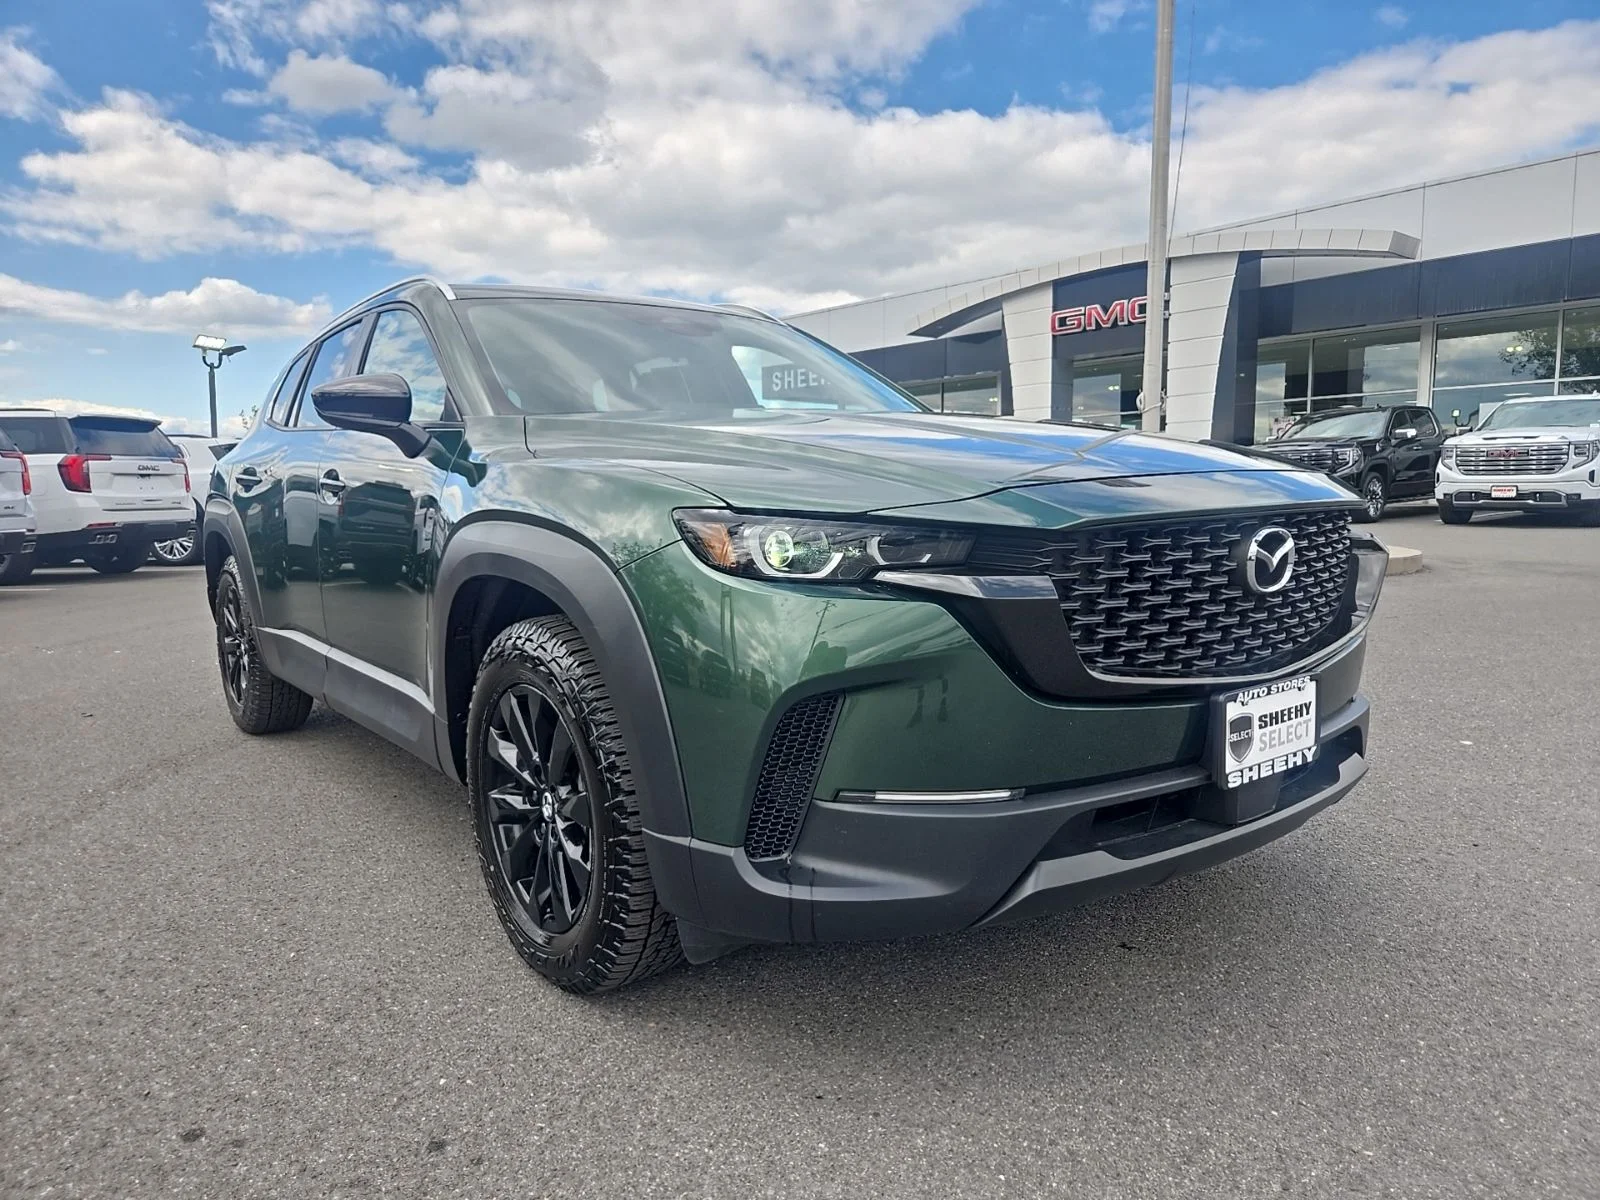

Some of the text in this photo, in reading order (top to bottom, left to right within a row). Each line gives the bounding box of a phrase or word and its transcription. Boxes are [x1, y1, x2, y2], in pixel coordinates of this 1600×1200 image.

[1050, 295, 1148, 336] GMC
[772, 368, 831, 392] SHEE
[1487, 448, 1529, 458] GMC
[1236, 676, 1311, 704] AUTO STORES
[1258, 701, 1313, 729] SHEEHY
[1229, 729, 1253, 743] SELECT
[1258, 718, 1311, 752] SELECT
[1227, 745, 1318, 789] SHEEHY
